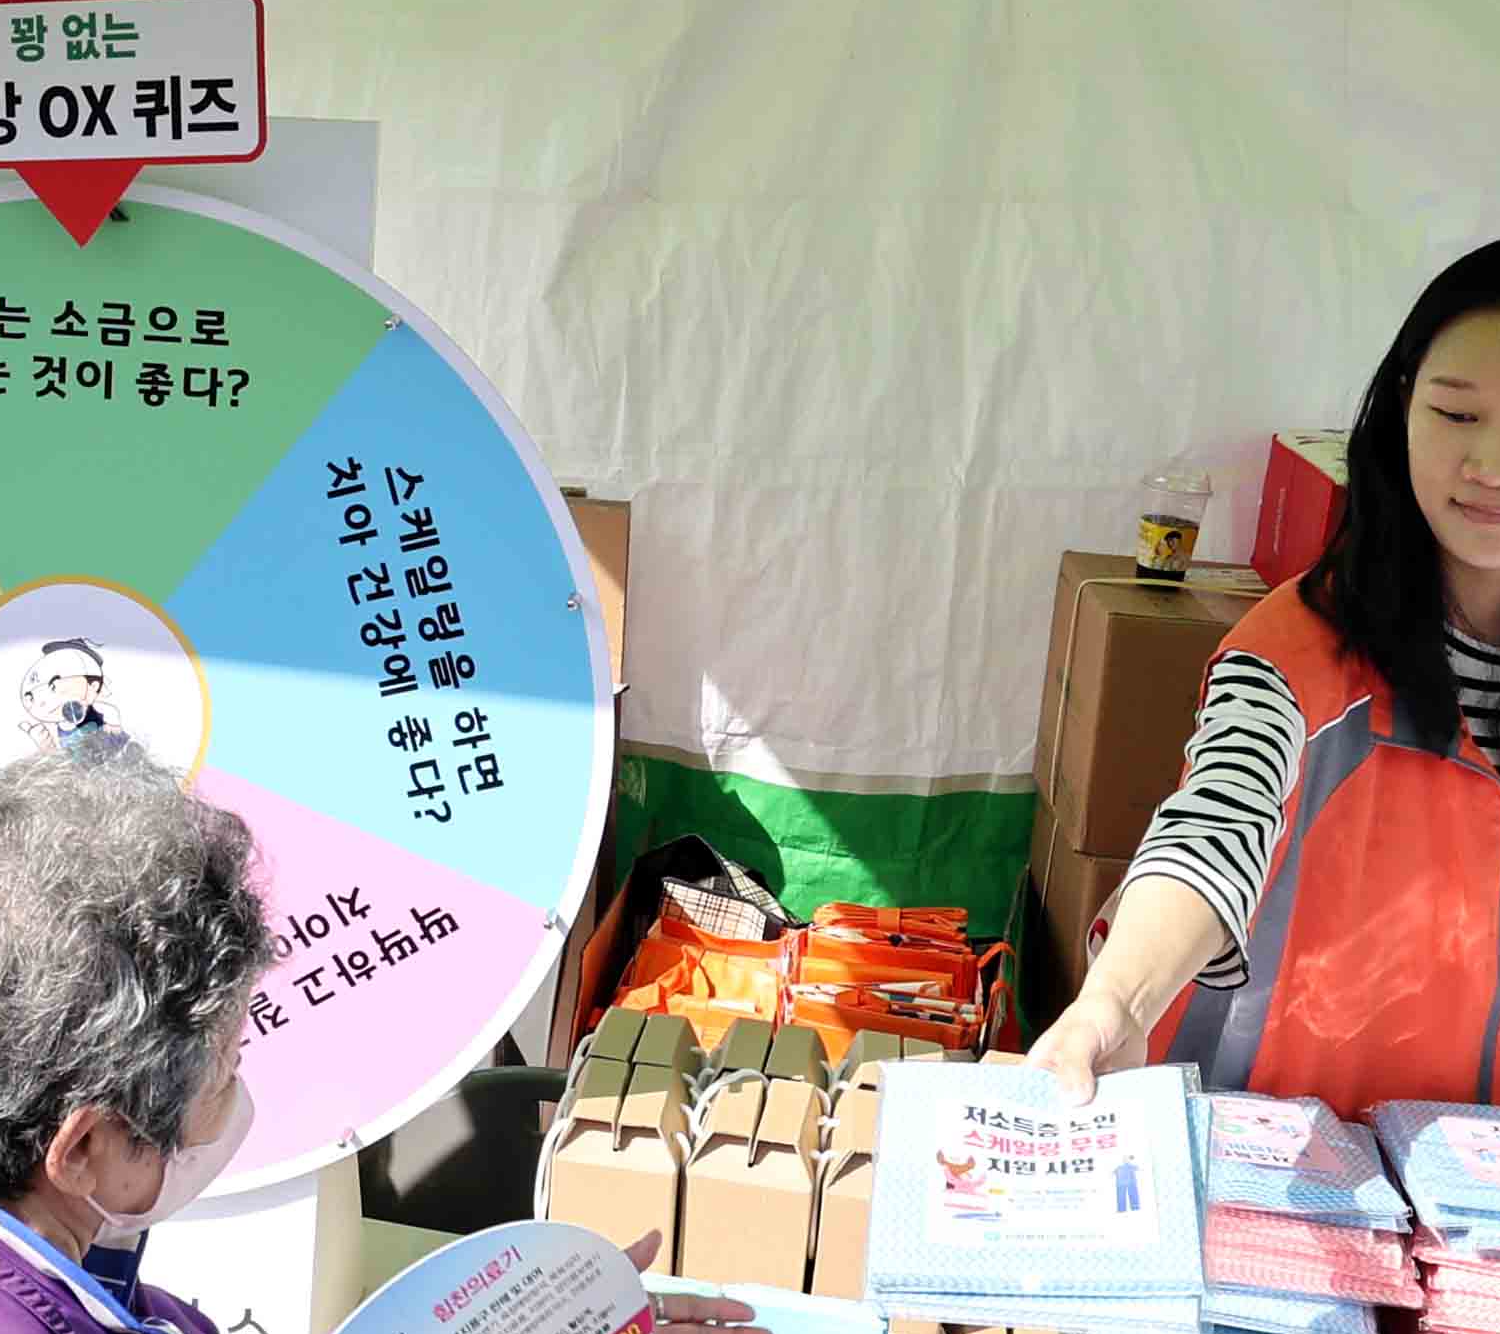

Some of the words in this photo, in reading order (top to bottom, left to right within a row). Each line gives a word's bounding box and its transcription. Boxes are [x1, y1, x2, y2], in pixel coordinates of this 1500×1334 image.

[11, 14, 47, 62] 꽝
[63, 12, 139, 60] 없는
[39, 83, 118, 138] OX
[133, 75, 240, 140] 퀴즈
[51, 300, 231, 348] 소금으로
[33, 356, 116, 401] 것이
[136, 363, 251, 410] 좋다?
[325, 454, 373, 546] 치아
[344, 564, 417, 700] 건강에
[383, 463, 479, 694] 스케일링을
[452, 706, 506, 793] 하면
[387, 714, 453, 825] 좋다?
[292, 906, 461, 1007] 딱딱하고
[963, 1104, 1060, 1138] 저소득층
[1069, 1112, 1117, 1133] 노인
[1070, 1133, 1118, 1154] 무료
[986, 1157, 1036, 1176] 지원
[1045, 1157, 1095, 1175] 사업
